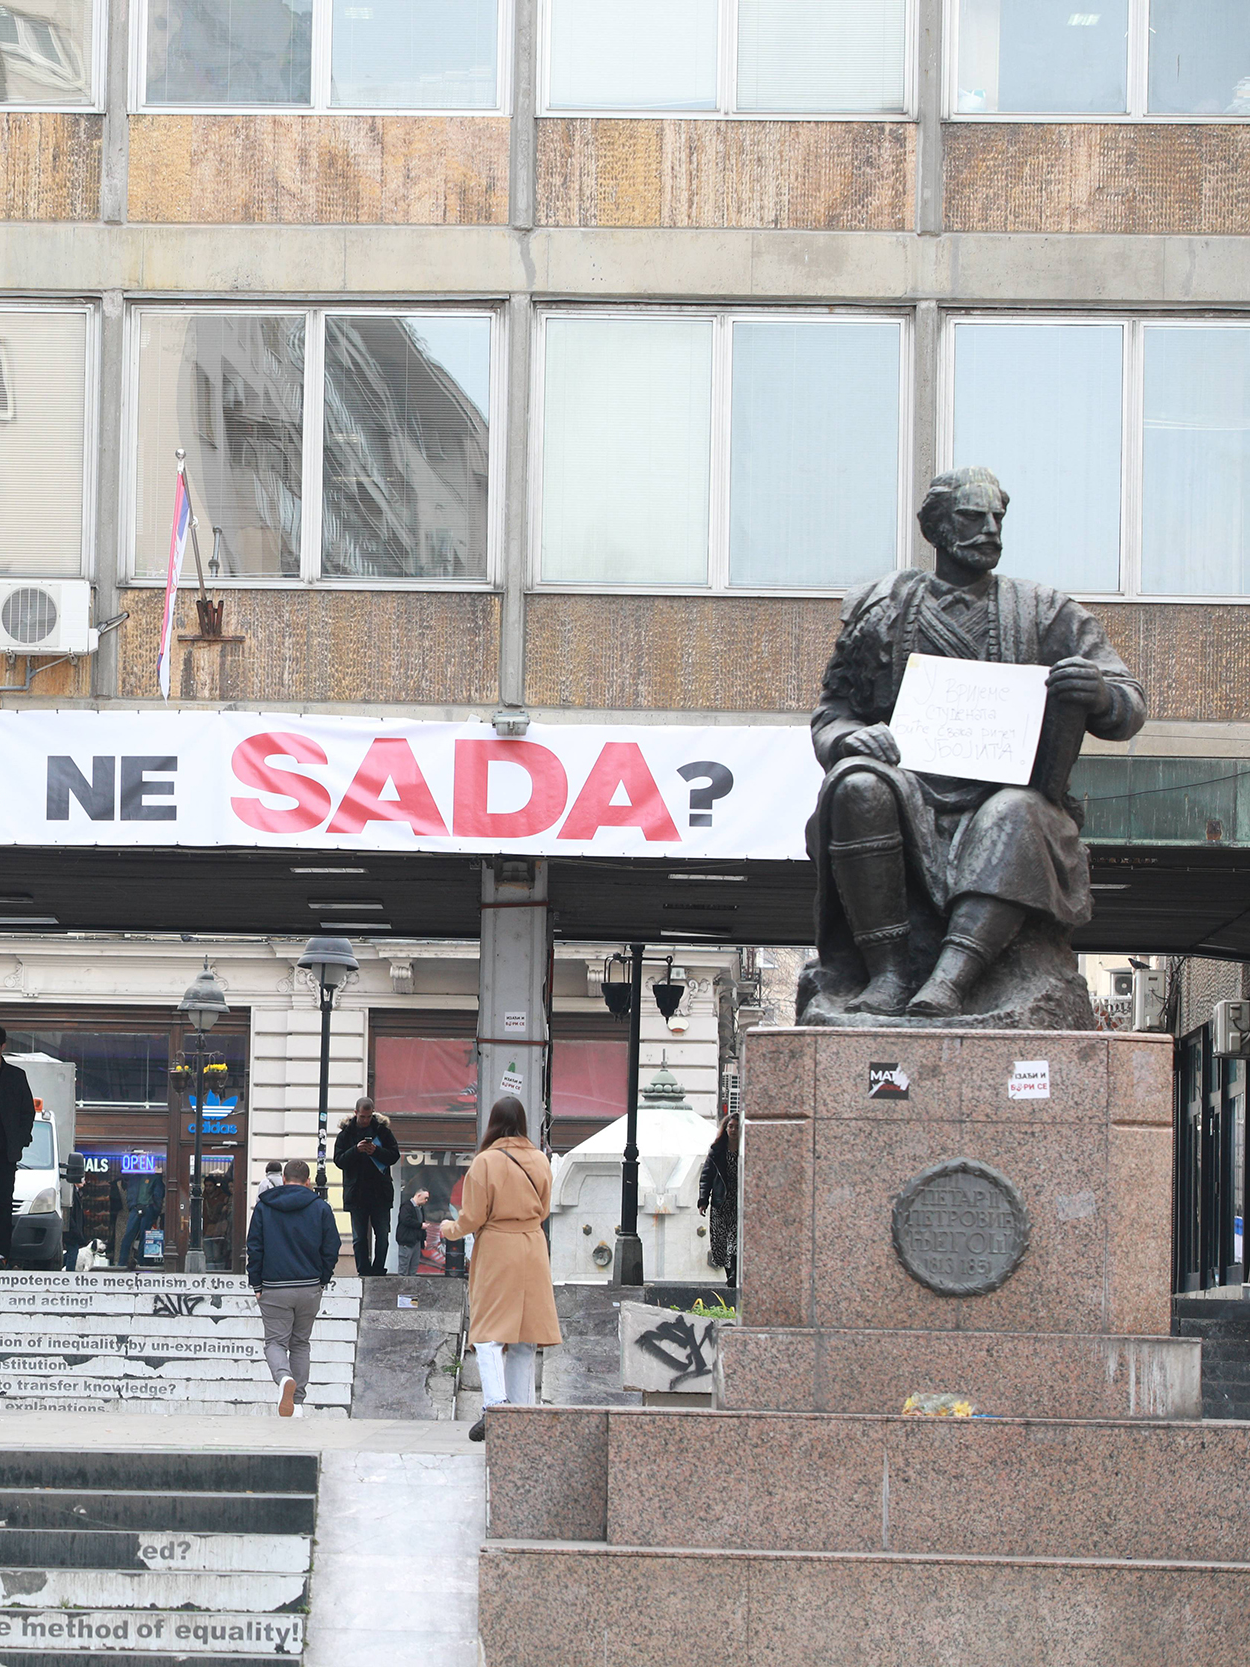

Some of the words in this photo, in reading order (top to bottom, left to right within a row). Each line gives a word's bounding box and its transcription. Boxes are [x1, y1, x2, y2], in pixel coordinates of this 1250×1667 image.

[47, 755, 179, 821] NE
[230, 732, 734, 842] SADA?
[83, 1158, 109, 1172] ALS
[122, 1155, 154, 1170] OPEN
[75, 1275, 98, 1286] the
[103, 1276, 187, 1289] mechanism
[192, 1277, 206, 1289] of
[210, 1277, 234, 1289] the
[9, 1295, 36, 1306] and
[41, 1295, 93, 1308] acting!
[27, 1337, 42, 1348] of
[48, 1338, 125, 1352] inequality
[129, 1339, 146, 1353] by
[151, 1341, 258, 1355] un-explaining.
[17, 1380, 79, 1391] transfer
[84, 1382, 176, 1396] knowledge?
[142, 1541, 191, 1560] ed?
[22, 1618, 129, 1639] method
[137, 1619, 165, 1639] of
[175, 1621, 299, 1645] equality!
